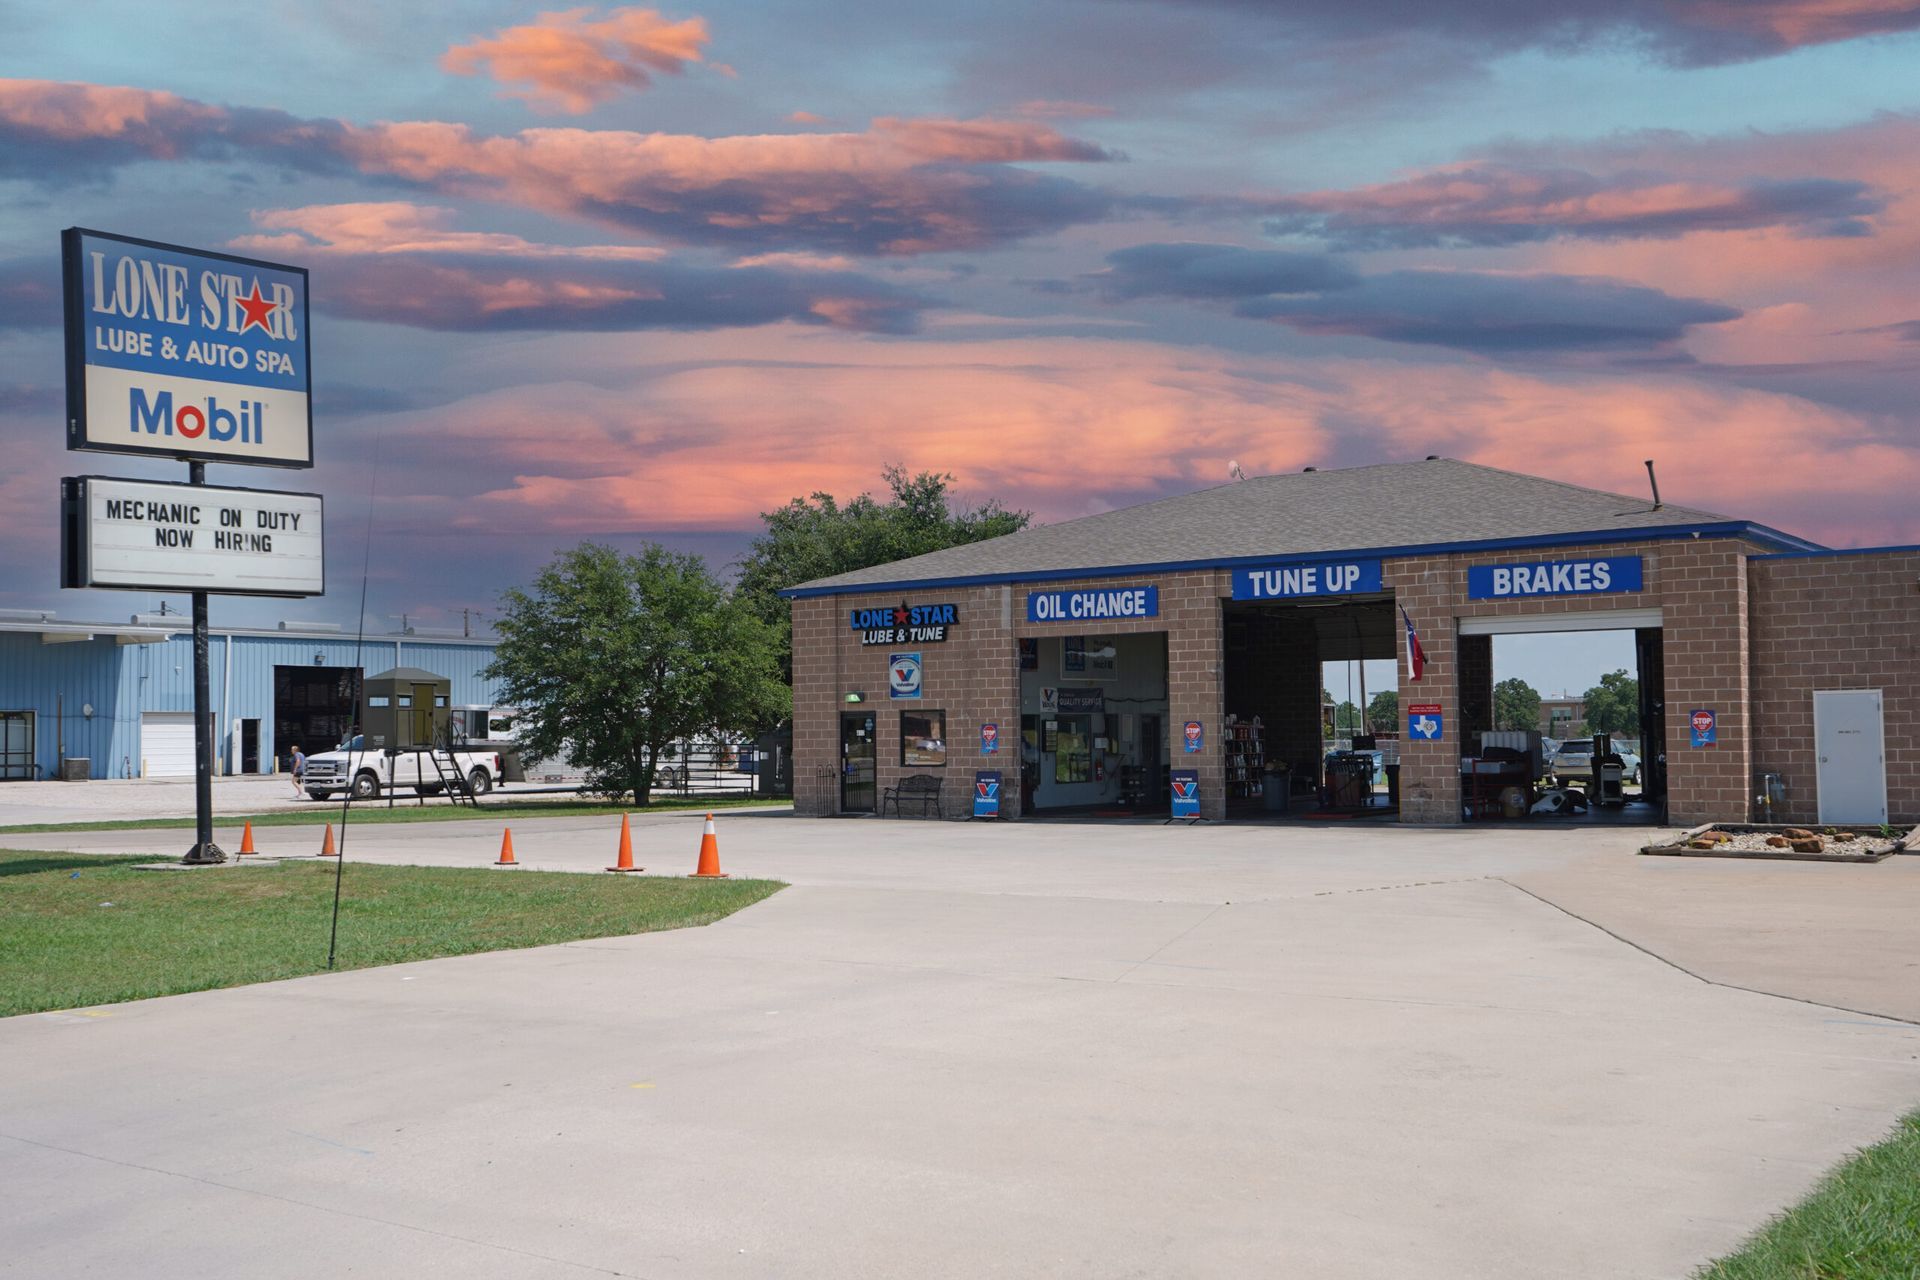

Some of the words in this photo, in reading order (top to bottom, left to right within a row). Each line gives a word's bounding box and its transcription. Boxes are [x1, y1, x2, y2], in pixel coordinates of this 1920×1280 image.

[90, 251, 190, 326] LONE
[95, 326, 153, 357] LUBE
[160, 336, 180, 361] &
[185, 340, 249, 370] AUTO
[255, 349, 296, 376] SPA
[129, 387, 263, 445] Mobil
[106, 499, 200, 525] MECHANIC
[220, 508, 242, 528] ON
[257, 509, 301, 531] DUTY
[155, 527, 194, 548] NOW
[1248, 567, 1317, 597] TUNE
[1325, 565, 1360, 592] UP
[1493, 561, 1611, 595] BRAKES
[850, 608, 894, 628] LONE
[911, 605, 955, 625] STAR
[1036, 594, 1066, 619] OIL
[1070, 590, 1146, 618] CHANGE
[862, 629, 894, 644] LUBE
[896, 628, 905, 642] &
[909, 626, 944, 641] TUNE
[1693, 717, 1712, 725] STOP
